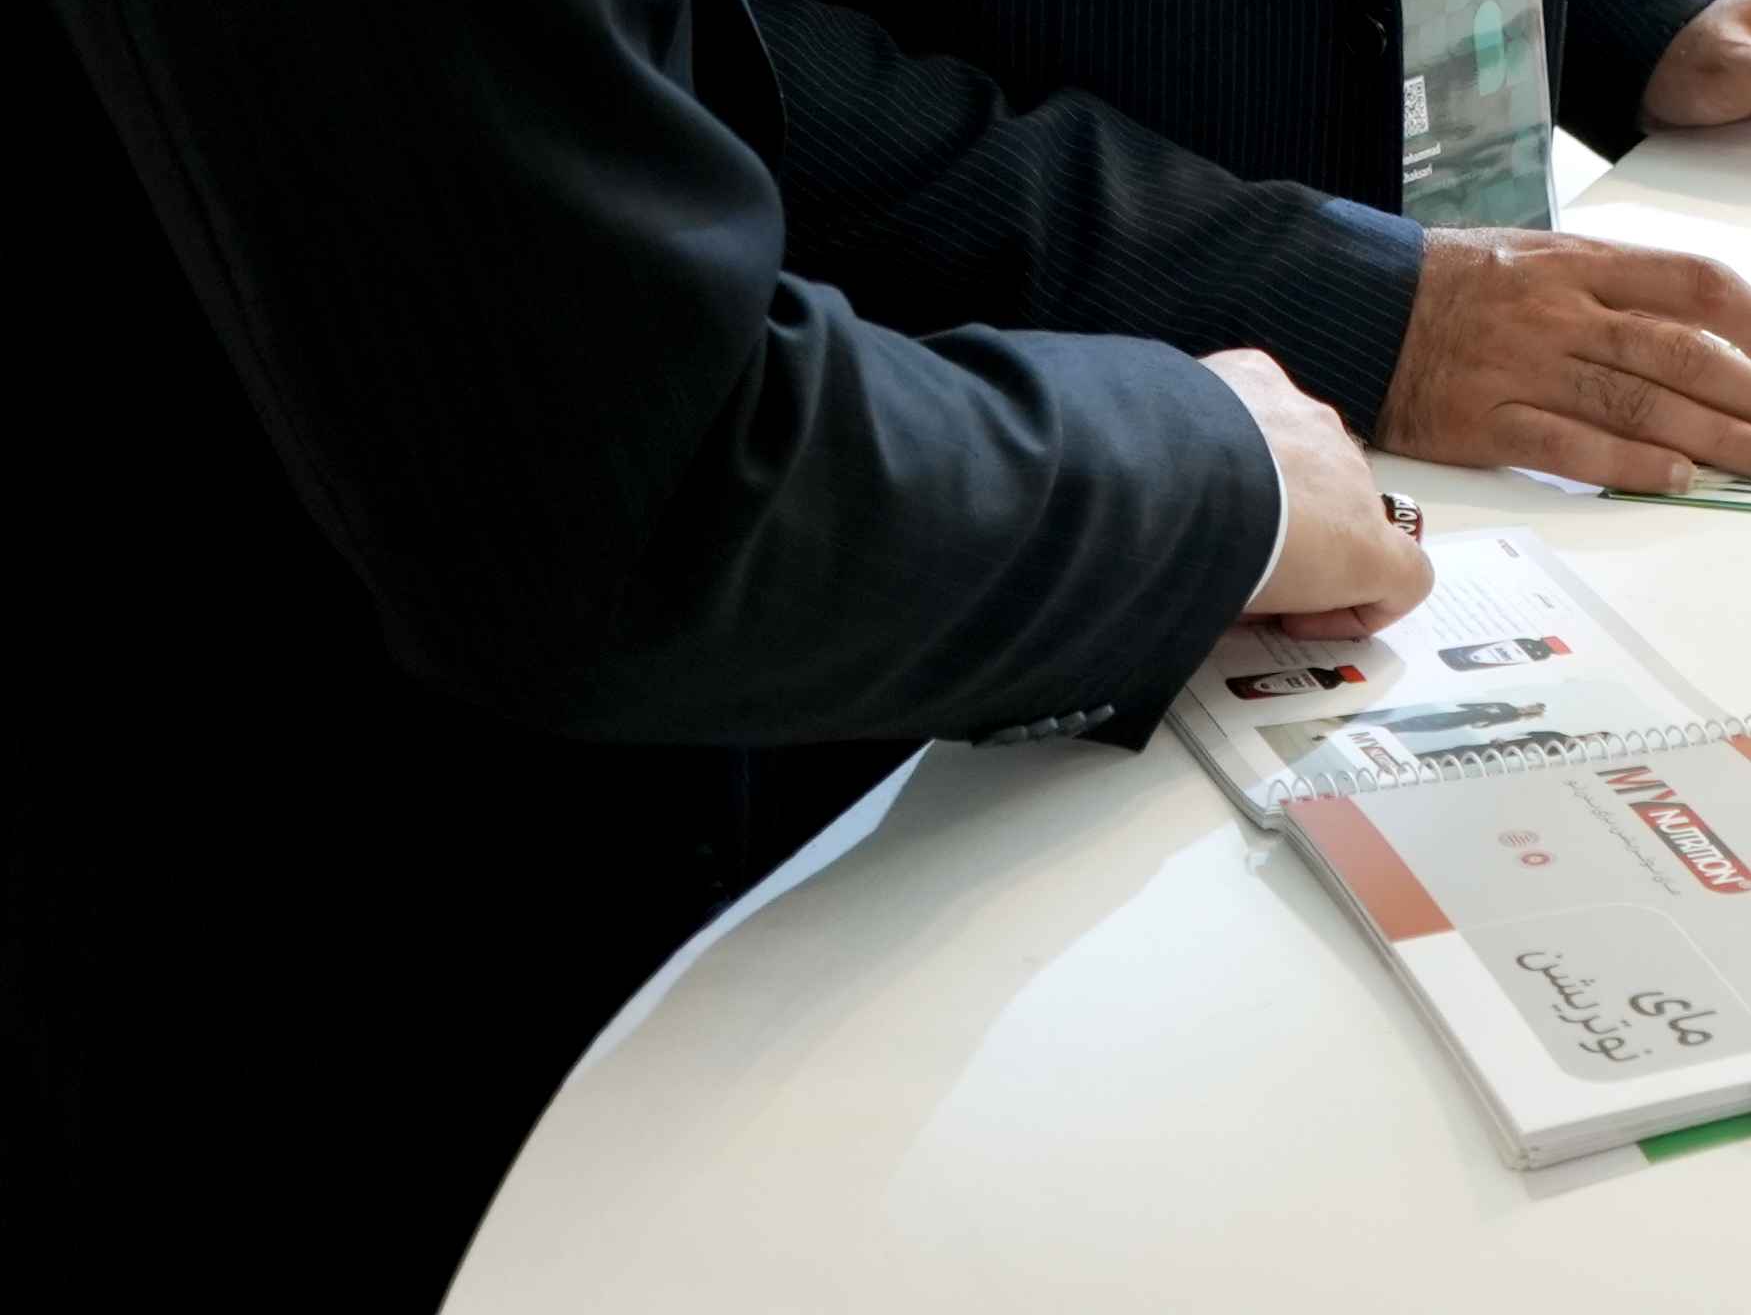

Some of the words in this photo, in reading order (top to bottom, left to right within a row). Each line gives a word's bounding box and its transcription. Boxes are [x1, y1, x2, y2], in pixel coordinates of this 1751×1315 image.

[1648, 808, 1745, 885] NUTRITION
[1516, 951, 1654, 1061] نوتریشن
[1628, 991, 1717, 1046] مای
